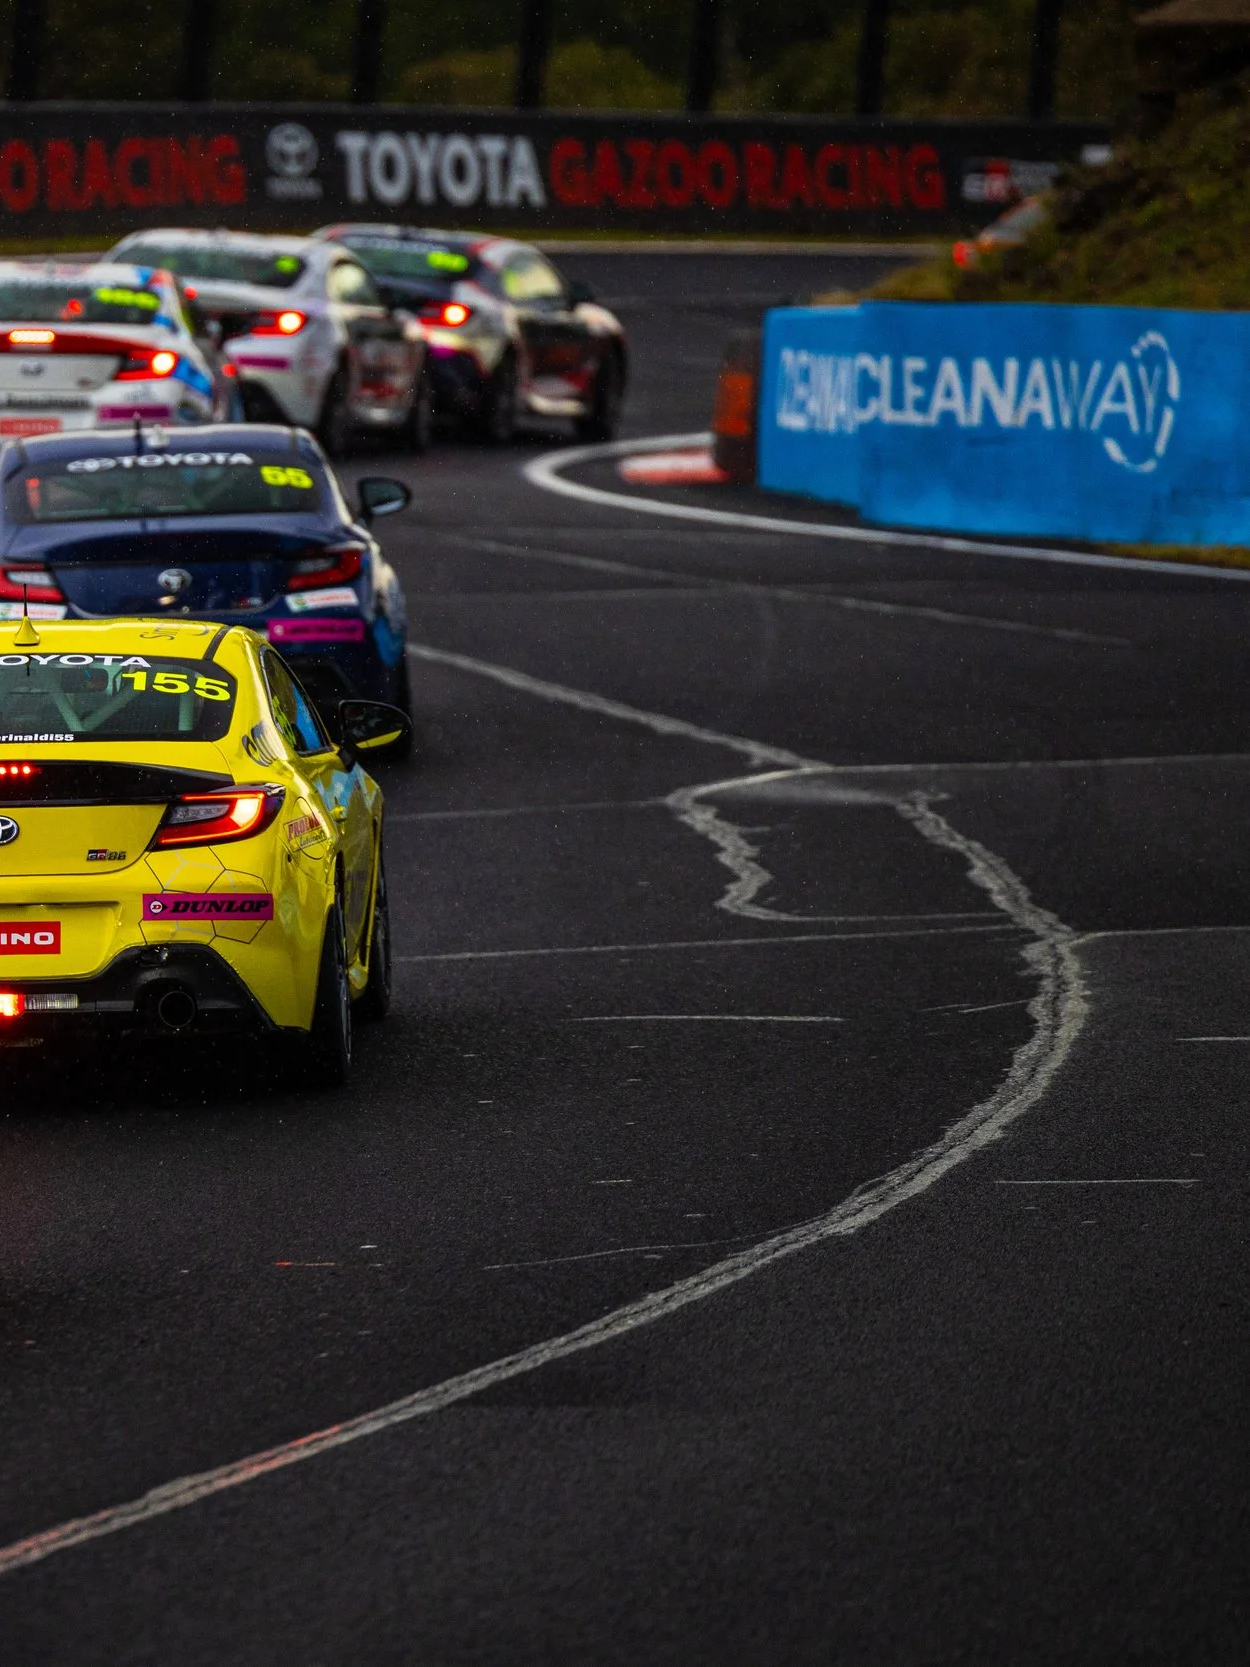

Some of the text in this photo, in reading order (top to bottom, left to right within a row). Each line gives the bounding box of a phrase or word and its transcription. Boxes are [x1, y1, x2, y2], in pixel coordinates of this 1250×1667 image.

[47, 135, 247, 208] RACING
[336, 130, 548, 207] TOYOTA
[551, 137, 738, 209] GAZOO
[744, 140, 946, 209] RACING
[854, 351, 1162, 434] CLEANAWAY
[115, 452, 254, 468] TOYOTA
[121, 671, 231, 701] 155
[169, 900, 270, 914] DUNLOP
